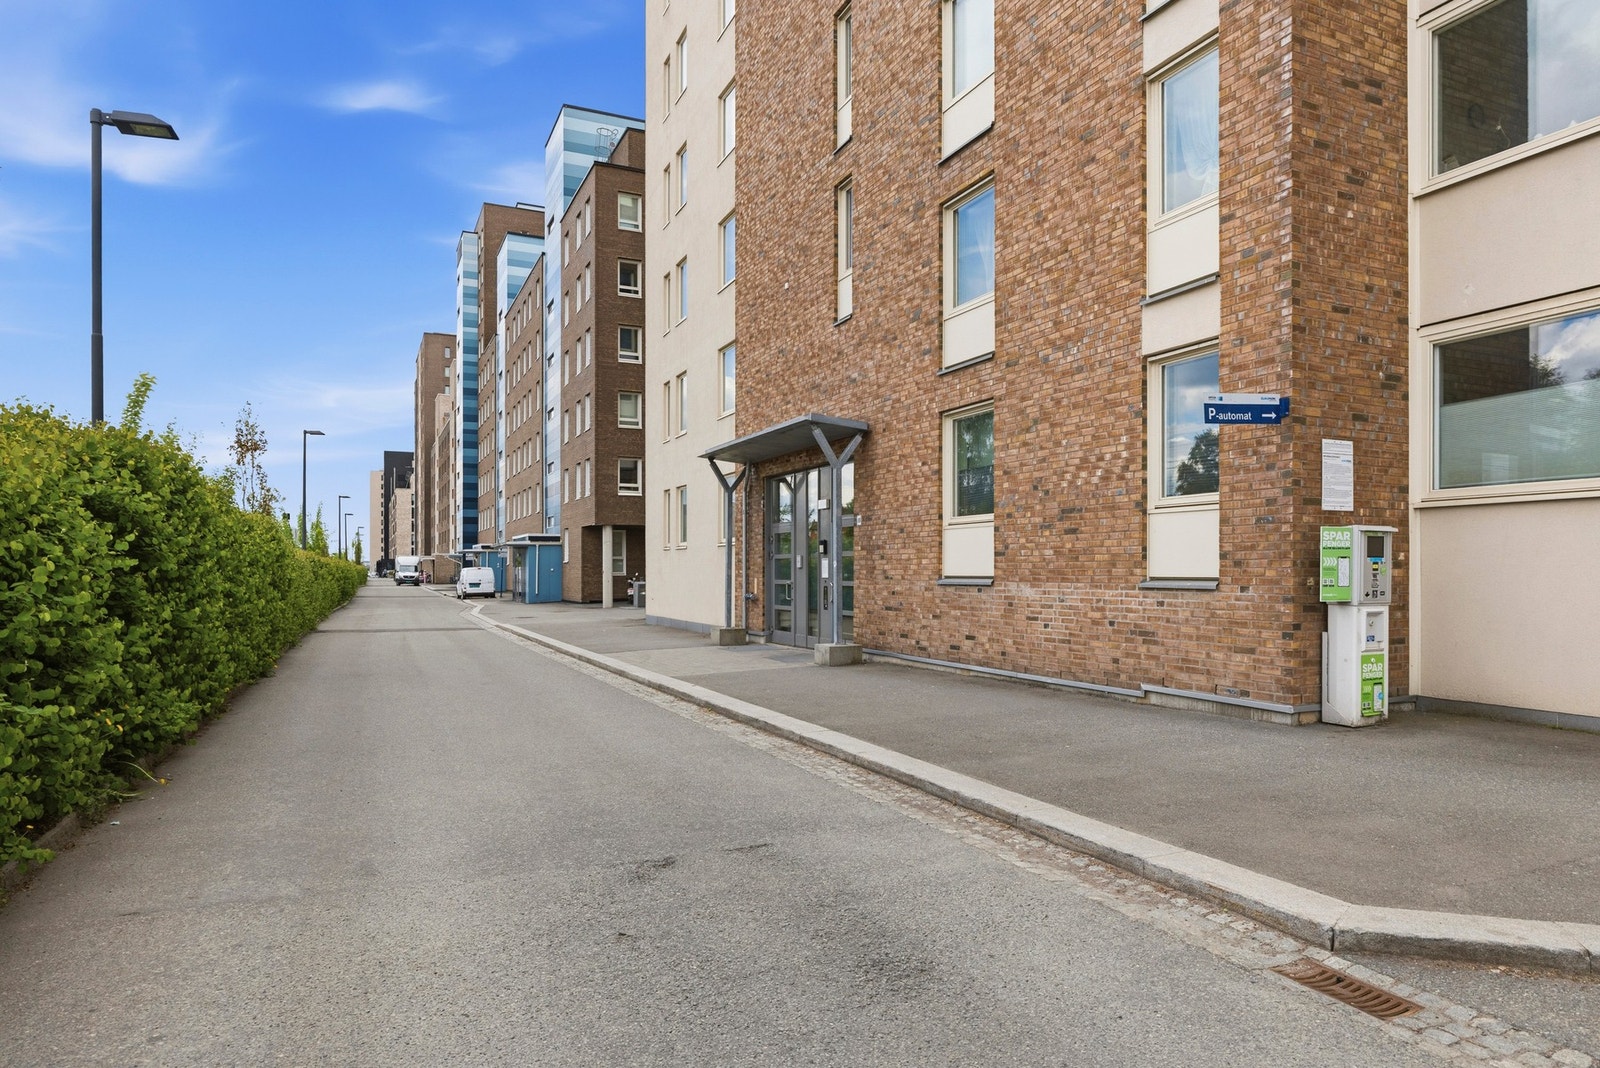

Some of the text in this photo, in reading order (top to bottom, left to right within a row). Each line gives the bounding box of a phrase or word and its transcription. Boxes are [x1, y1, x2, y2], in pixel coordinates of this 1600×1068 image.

[1208, 407, 1252, 420] P-automat
[1322, 530, 1351, 541] SPAR
[1362, 662, 1383, 673] SPAR
